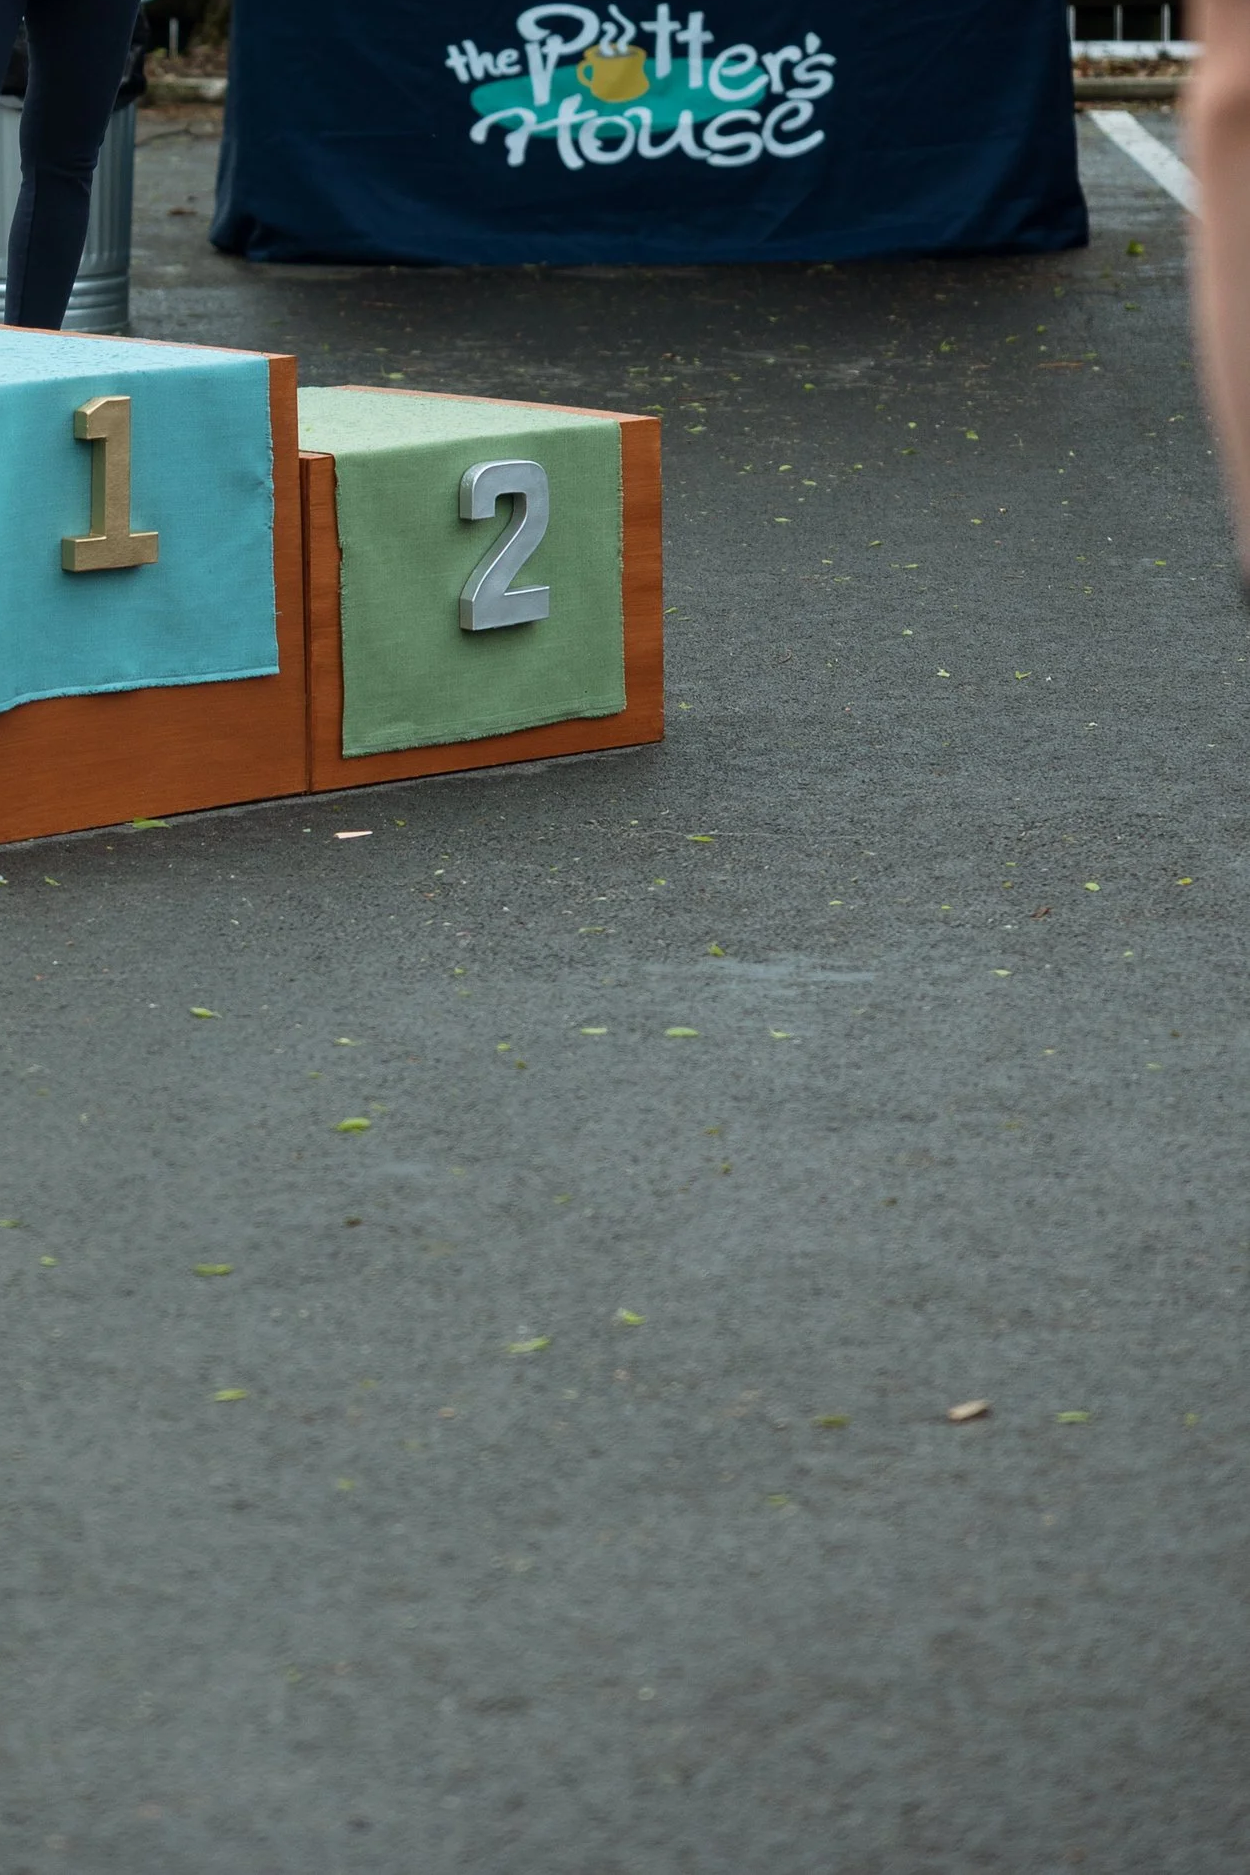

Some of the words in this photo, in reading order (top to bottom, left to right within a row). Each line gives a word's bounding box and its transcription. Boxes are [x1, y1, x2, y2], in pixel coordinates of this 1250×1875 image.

[445, 39, 522, 84] the
[469, 93, 825, 171] House
[60, 395, 160, 573] 1
[458, 458, 550, 632] 2
